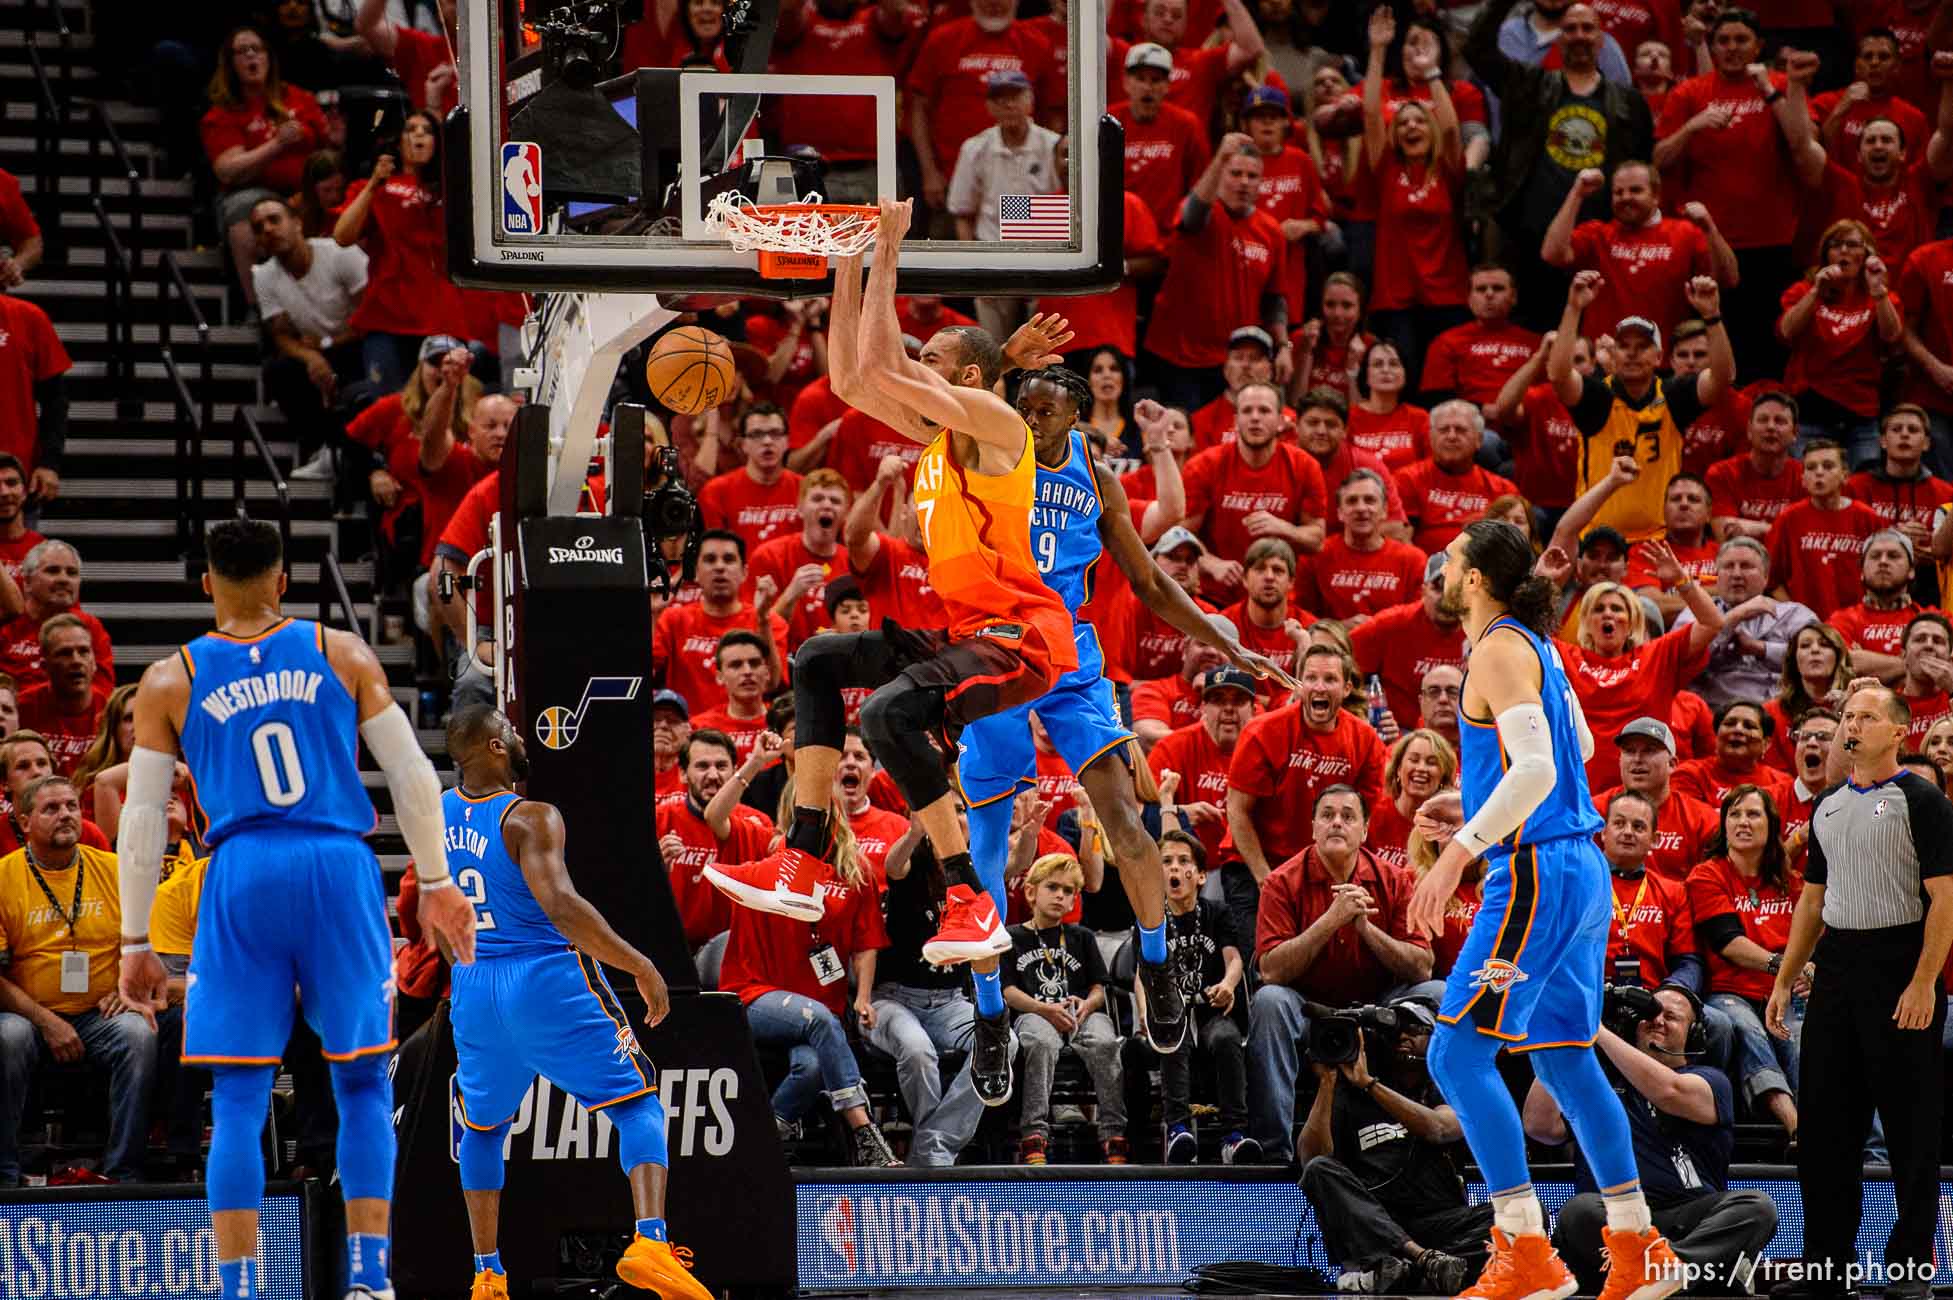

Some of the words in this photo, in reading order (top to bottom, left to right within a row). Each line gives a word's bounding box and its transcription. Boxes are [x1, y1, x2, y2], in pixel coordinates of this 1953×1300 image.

[507, 213, 528, 230] NBA
[500, 249, 544, 262] SPALDING
[776, 255, 820, 266] SPALDING
[1353, 433, 1382, 449] TAKE
[1381, 432, 1414, 449] NOTE
[1221, 495, 1251, 511] TAKE
[1251, 496, 1289, 512] NOTE
[1456, 494, 1489, 511] NOTE
[1031, 507, 1069, 531] CITY
[1038, 531, 1057, 574] 9
[1800, 535, 1830, 552] TAKE
[548, 546, 624, 566] SPALDING
[1330, 573, 1362, 589] TAKE
[1363, 575, 1401, 591] NOTE
[503, 550, 517, 704] NBA
[1863, 626, 1896, 640] TAKE
[201, 669, 324, 725] WESTBROOK
[251, 721, 306, 807] 0
[1288, 752, 1317, 770] TAKE
[1315, 758, 1352, 776] NOTE
[1196, 773, 1228, 792] TAKE
[444, 824, 489, 860] FELTON
[1375, 847, 1408, 868] TAKE
[458, 867, 496, 930] 2
[1628, 907, 1664, 923] NOTE
[1016, 947, 1045, 972] ROOKIE
[859, 1194, 1181, 1276] NBAStore.com
[0, 1216, 266, 1298] AStore.co
